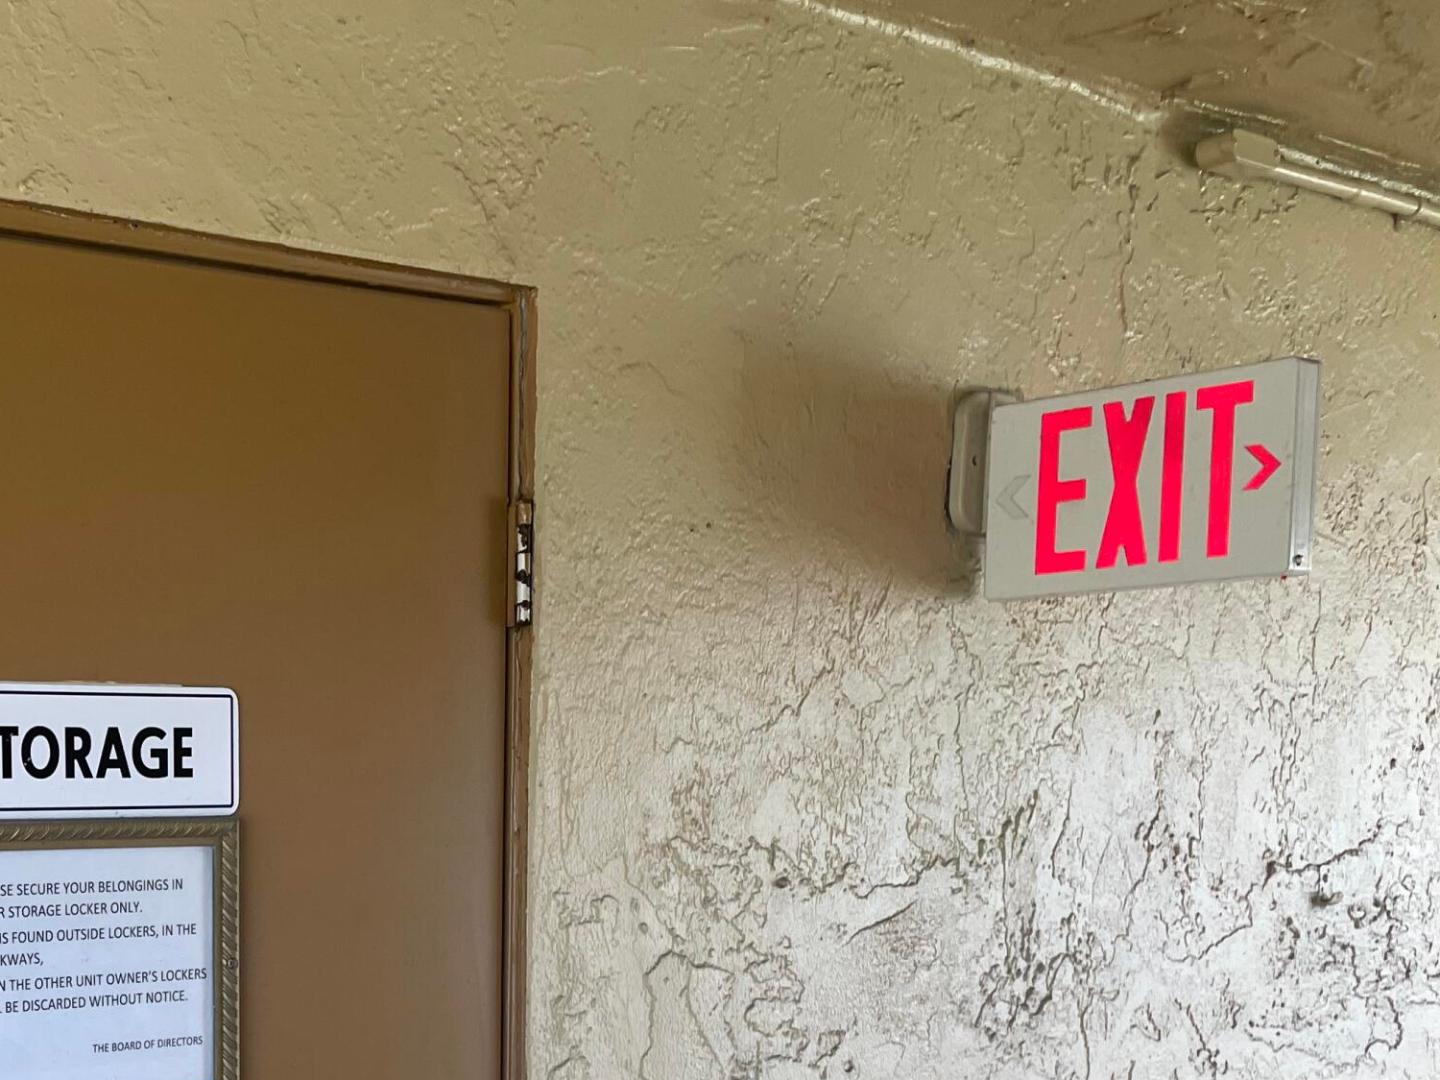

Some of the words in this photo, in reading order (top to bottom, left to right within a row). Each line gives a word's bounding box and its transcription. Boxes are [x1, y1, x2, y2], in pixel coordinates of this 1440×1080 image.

[1035, 380, 1254, 575] EXIT
[17, 883, 60, 895] SECURE
[63, 882, 95, 894] YOUR
[99, 879, 169, 892] BELONGINGS
[172, 879, 183, 890] IN
[8, 905, 61, 918] STORAGE
[65, 903, 107, 915] LOCKER
[110, 902, 143, 914] ONLY.
[12, 930, 53, 943] FOUND
[57, 928, 105, 941] OUTSIDE
[108, 926, 159, 938] LOCKERS,
[162, 925, 173, 936] IN
[177, 924, 197, 935] THE
[10, 979, 31, 990] THE
[34, 977, 73, 989] OTHER
[76, 975, 103, 987] UNIT
[106, 971, 157, 985] OWNER'S
[161, 968, 207, 981] LOCKERS
[5, 1002, 19, 1013] BE
[22, 998, 86, 1012] DISCARDED
[89, 993, 143, 1007] WITHOUT
[146, 991, 188, 1004] NOTICE.
[93, 1044, 109, 1053] THE
[112, 1041, 142, 1052] BOARD
[144, 1040, 155, 1049] OF
[157, 1036, 203, 1048] DIRECTORS
